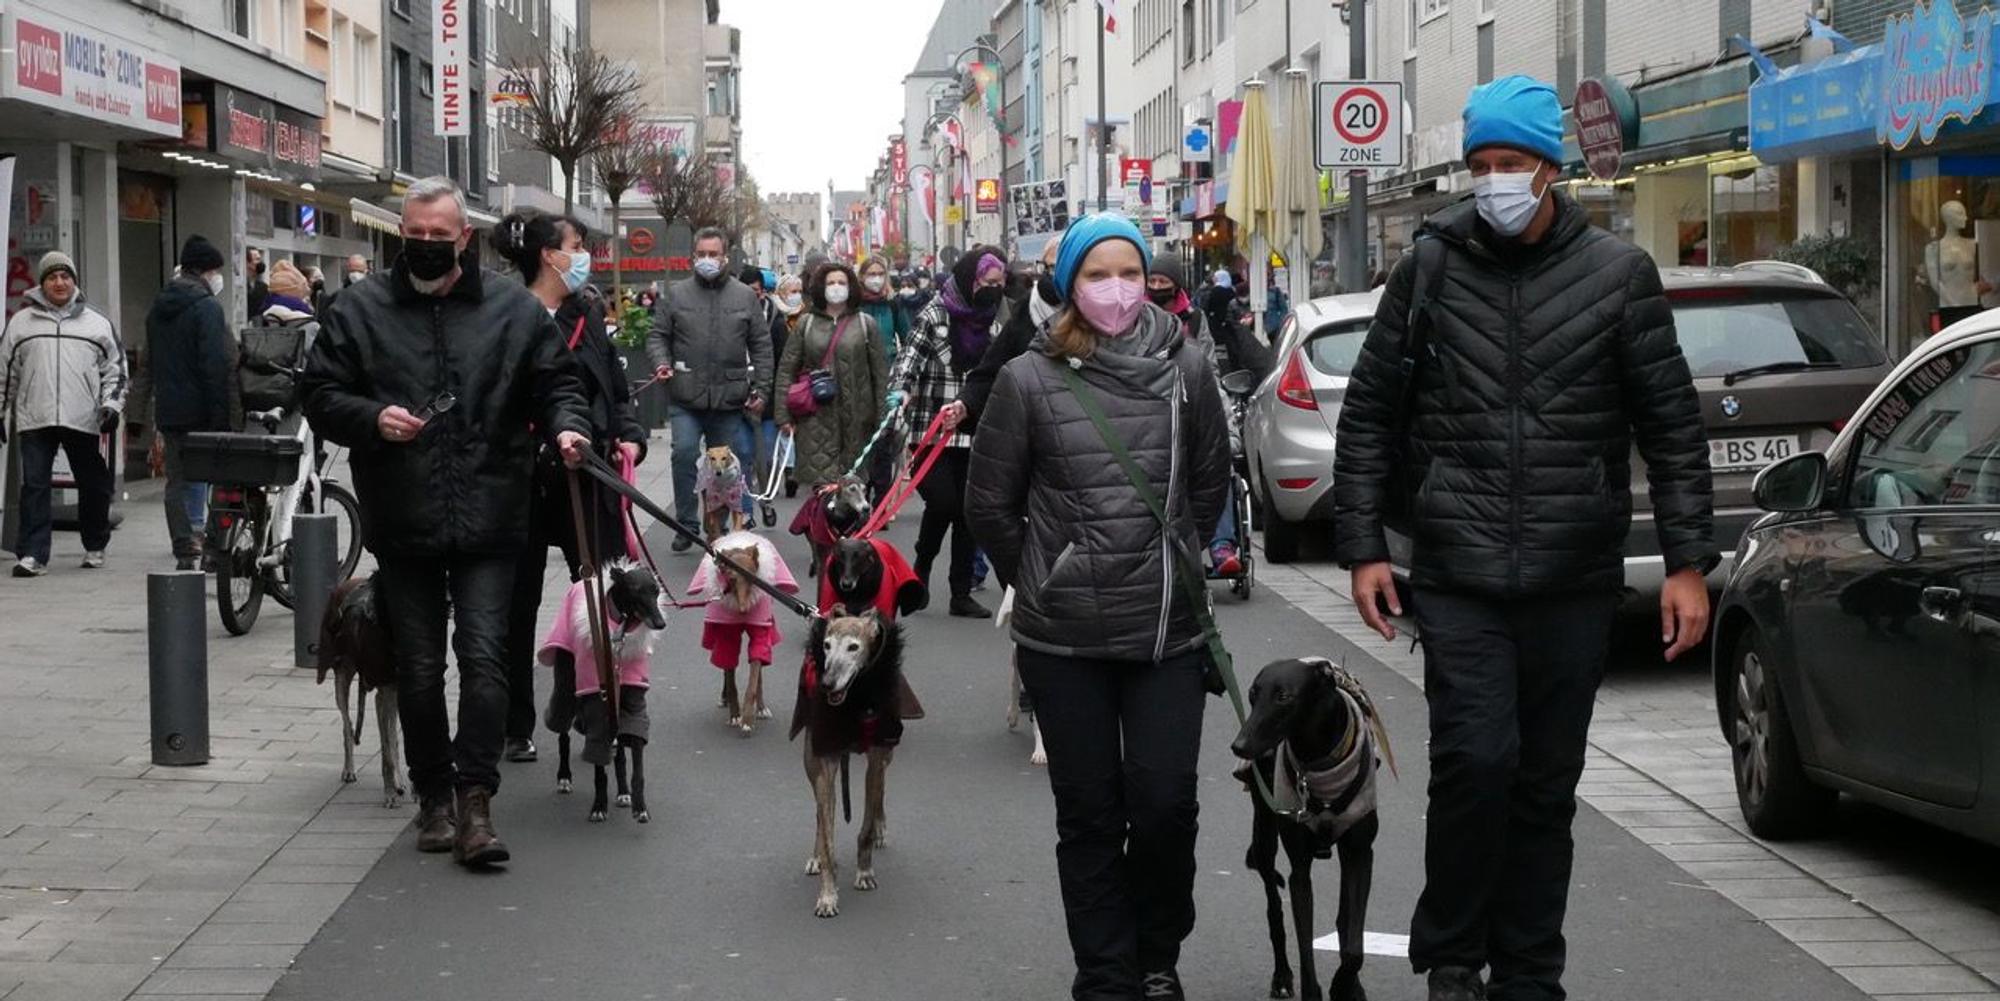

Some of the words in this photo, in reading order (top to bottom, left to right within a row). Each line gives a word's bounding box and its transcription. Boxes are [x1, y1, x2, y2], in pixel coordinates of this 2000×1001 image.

[65, 31, 106, 78] MOBILE
[117, 49, 142, 89] ZONE
[443, 64, 459, 131] TINTE
[1346, 103, 1377, 128] 20
[1340, 148, 1382, 162] ZONE
[1727, 441, 1757, 463] BS
